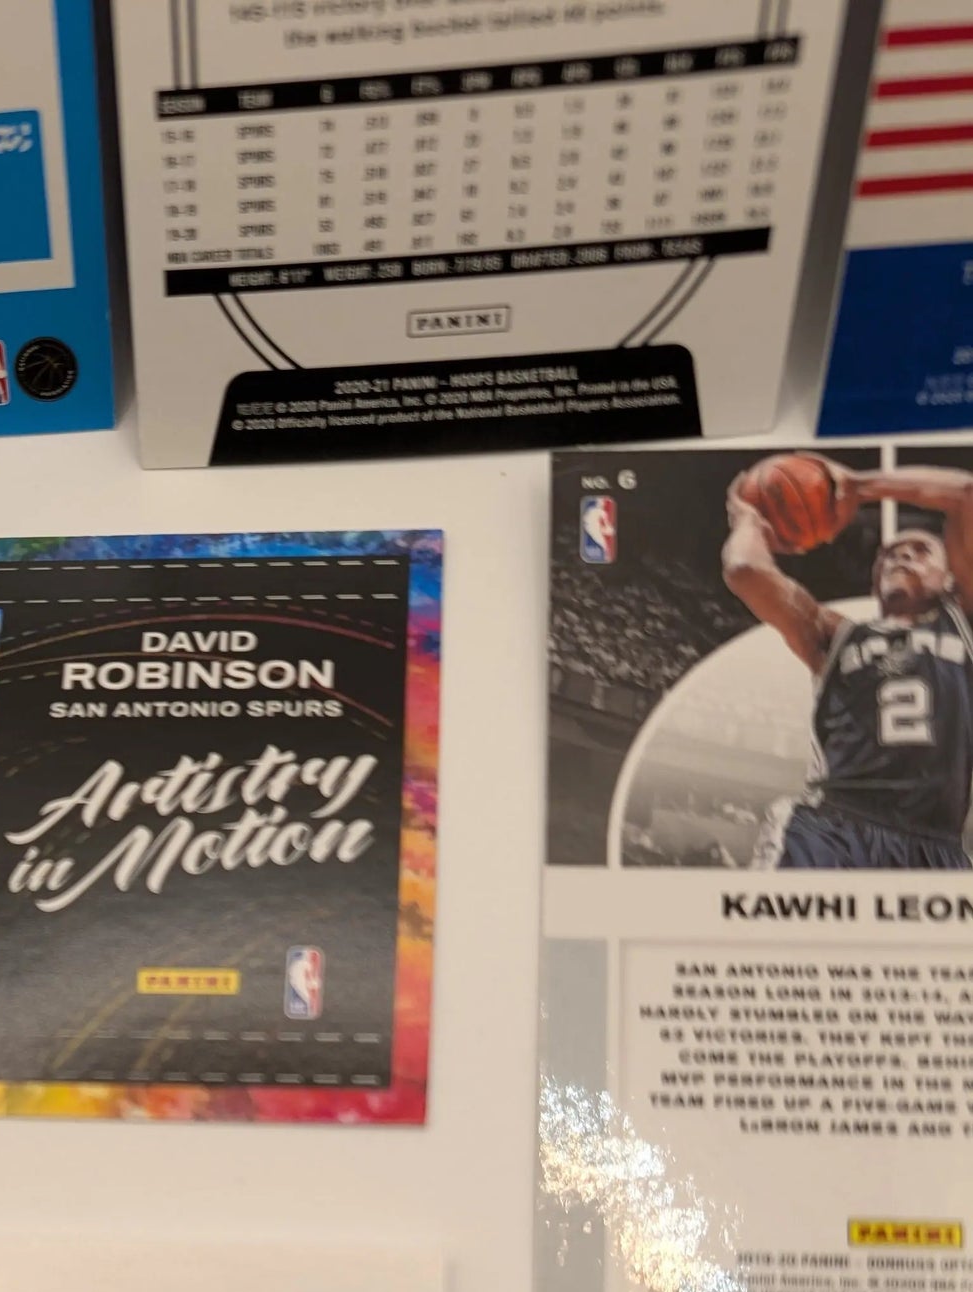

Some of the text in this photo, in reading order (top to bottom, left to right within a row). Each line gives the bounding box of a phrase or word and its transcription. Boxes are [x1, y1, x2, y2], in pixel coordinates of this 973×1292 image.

[416, 311, 503, 331] PANINI
[617, 469, 637, 490] 6
[141, 630, 258, 654] DAVID
[60, 658, 336, 692] ROBINSON
[49, 699, 344, 719] SAN ANTONIO SPURS
[878, 677, 935, 746] 2
[5, 743, 378, 845] Artistry
[7, 805, 376, 914] in Motion
[722, 893, 857, 922] KAWHI
[859, 1223, 954, 1243] PANINI
